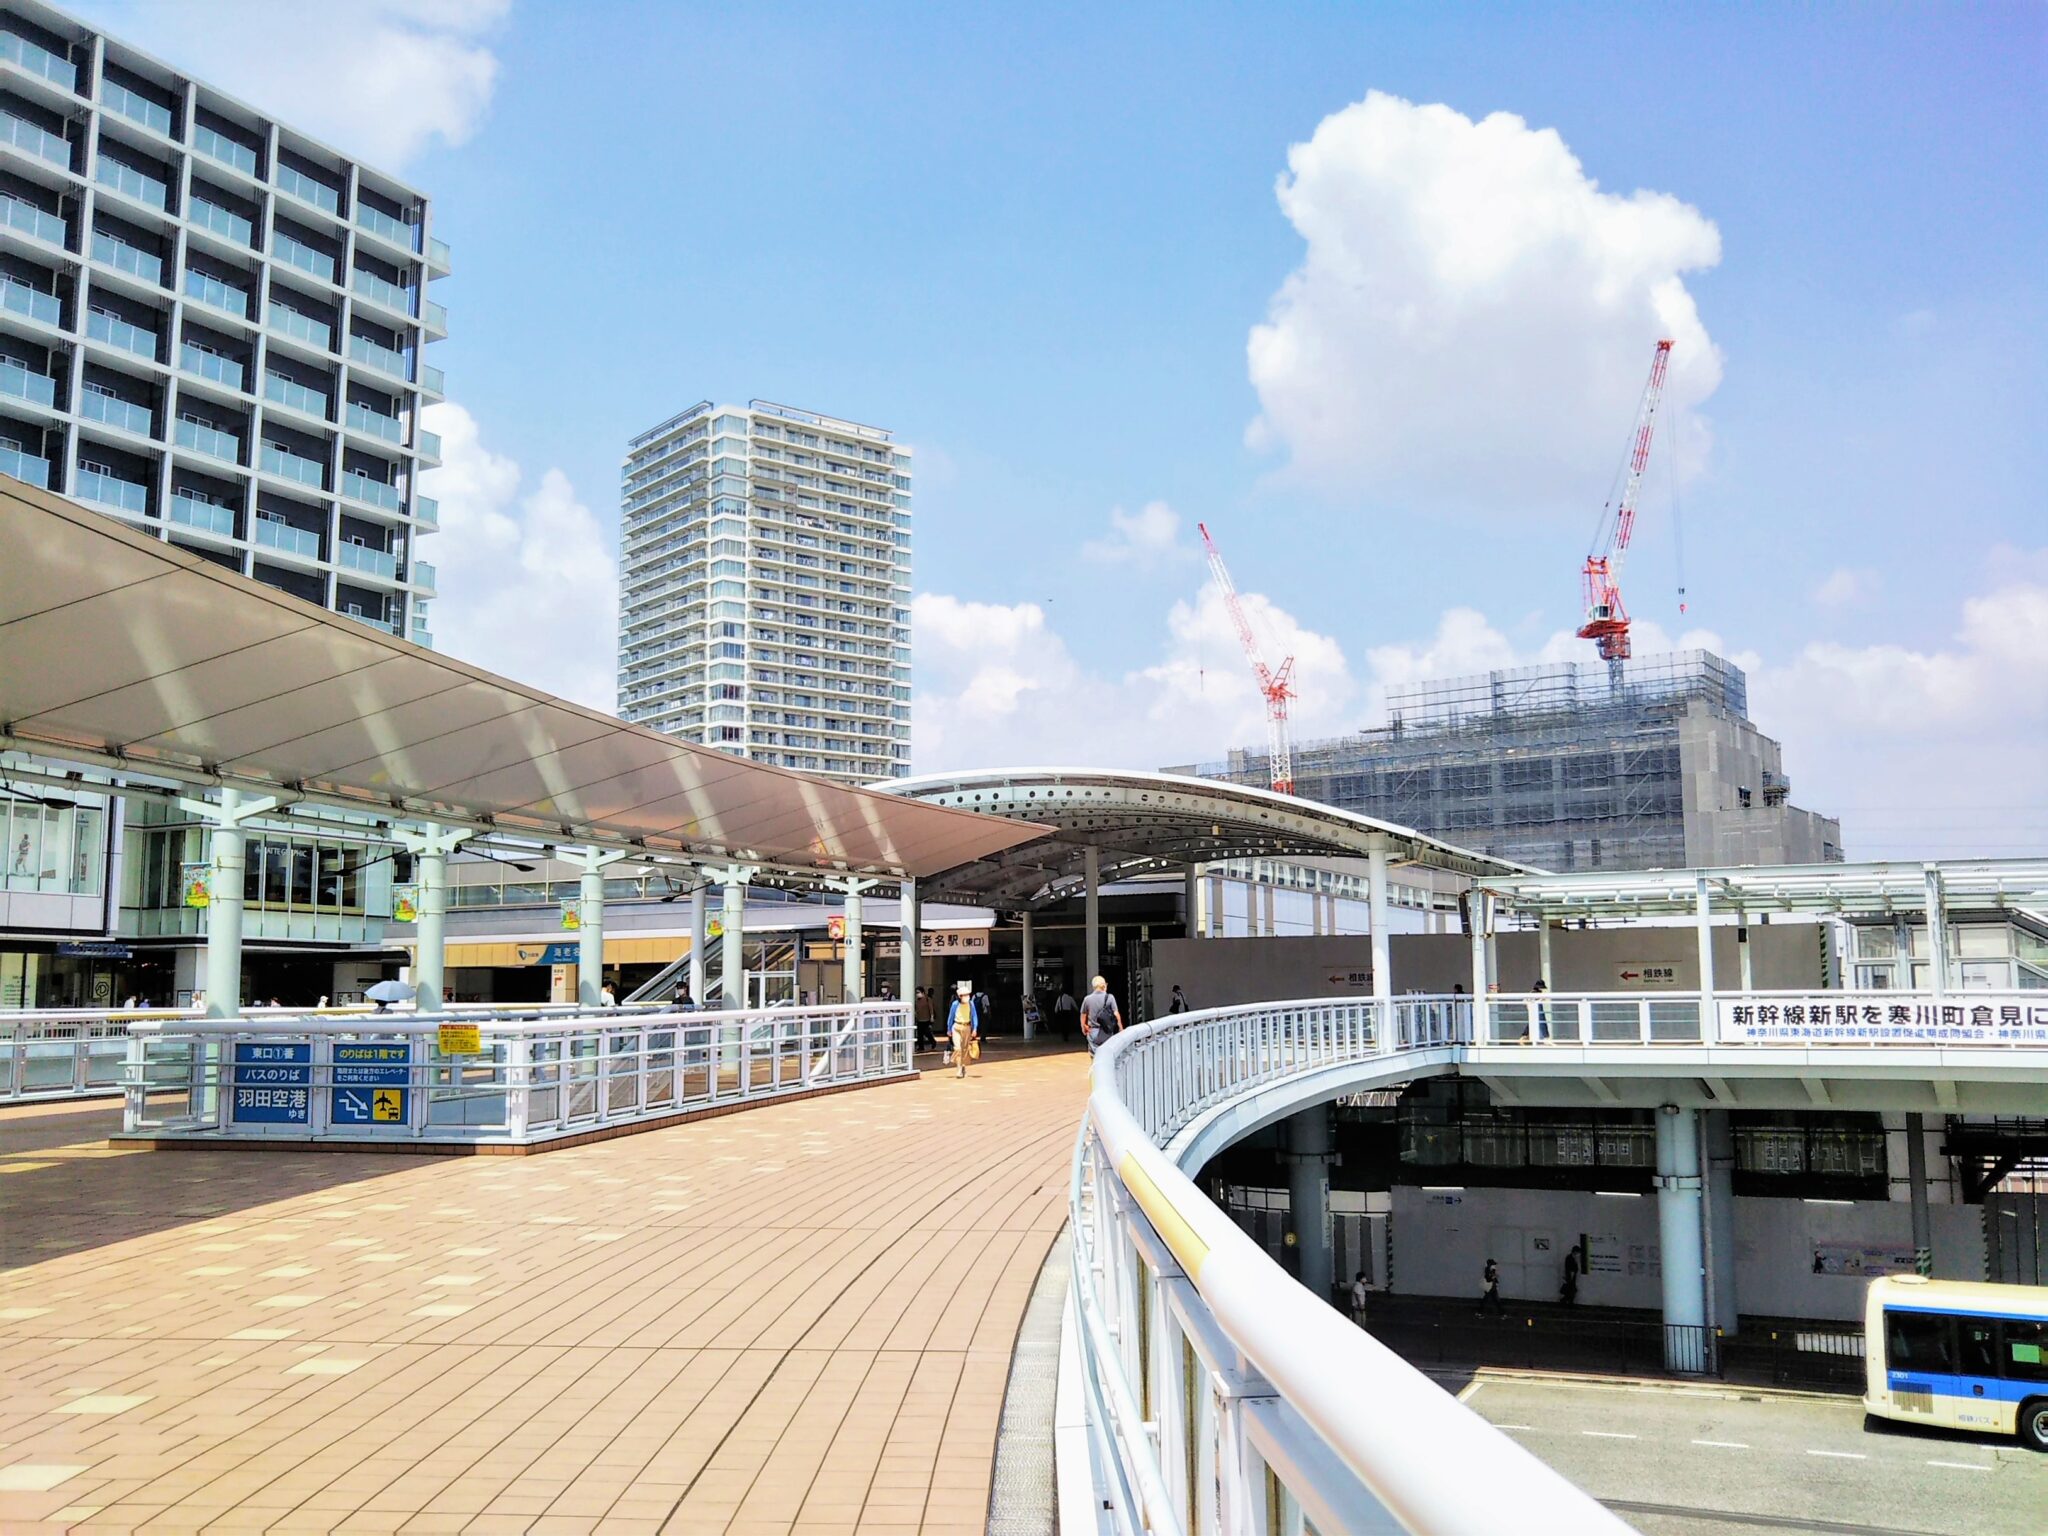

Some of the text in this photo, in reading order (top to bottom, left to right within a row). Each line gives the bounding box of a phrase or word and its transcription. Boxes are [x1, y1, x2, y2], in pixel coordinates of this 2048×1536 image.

[921, 934, 985, 947] 老名駅（東口）
[1732, 1005, 2048, 1026] 新幹線新駅を寒川町倉見に
[339, 1049, 406, 1060] のりばは1階です
[245, 1069, 300, 1081] バスのりば
[238, 1088, 307, 1108] 羽田空港
[288, 1109, 306, 1120] ゆき
[1891, 1371, 1908, 1380] 2301
